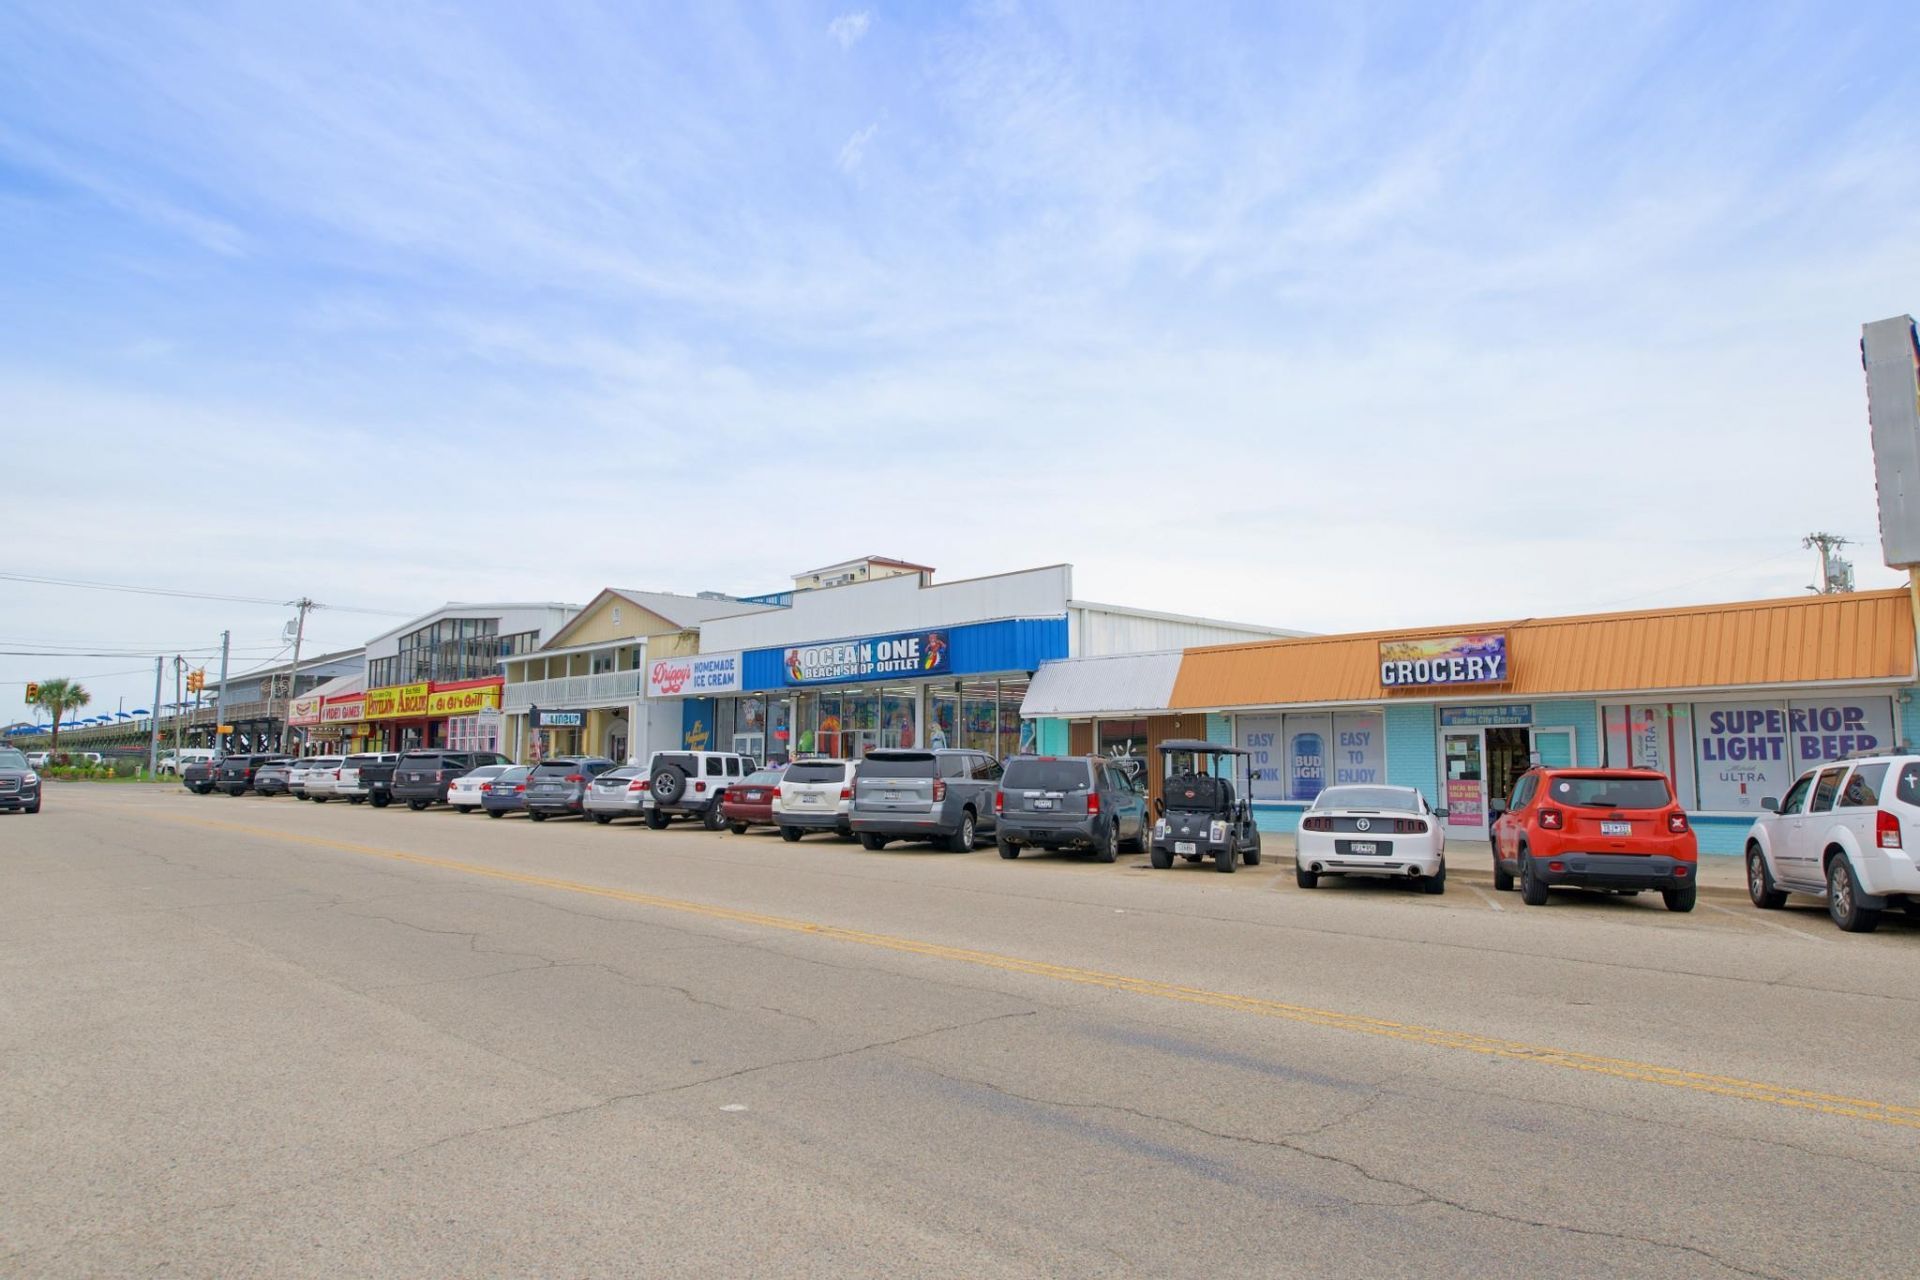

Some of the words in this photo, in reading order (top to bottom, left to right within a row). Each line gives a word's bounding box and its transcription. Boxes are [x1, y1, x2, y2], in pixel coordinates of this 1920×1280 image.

[805, 644, 872, 668] OCEAN
[876, 637, 920, 661] ONE
[694, 658, 735, 672] HOMEMADE
[805, 665, 841, 679] BEACH
[843, 662, 874, 676] SHOP
[876, 658, 920, 672] OUTLET
[1381, 655, 1501, 684] GROCERY
[652, 662, 691, 693] Drippy's
[694, 674, 706, 688] ICE
[707, 673, 735, 686] CREAM
[326, 705, 340, 719] VIDEO
[342, 705, 360, 718] GAMES
[1478, 716, 1493, 725] City
[1493, 715, 1522, 725] Grocery
[1710, 706, 1866, 735] SUPERIOR
[1247, 733, 1274, 747] EASY
[1340, 732, 1370, 746] EASY
[1645, 726, 1658, 768] ULTRA
[1703, 736, 1785, 761] LIGHT
[1254, 751, 1269, 764] TO
[1295, 755, 1321, 767] BUD
[1348, 750, 1364, 764] TO
[1338, 769, 1376, 783] ENJOY
[1719, 772, 1766, 782] ULTRA
